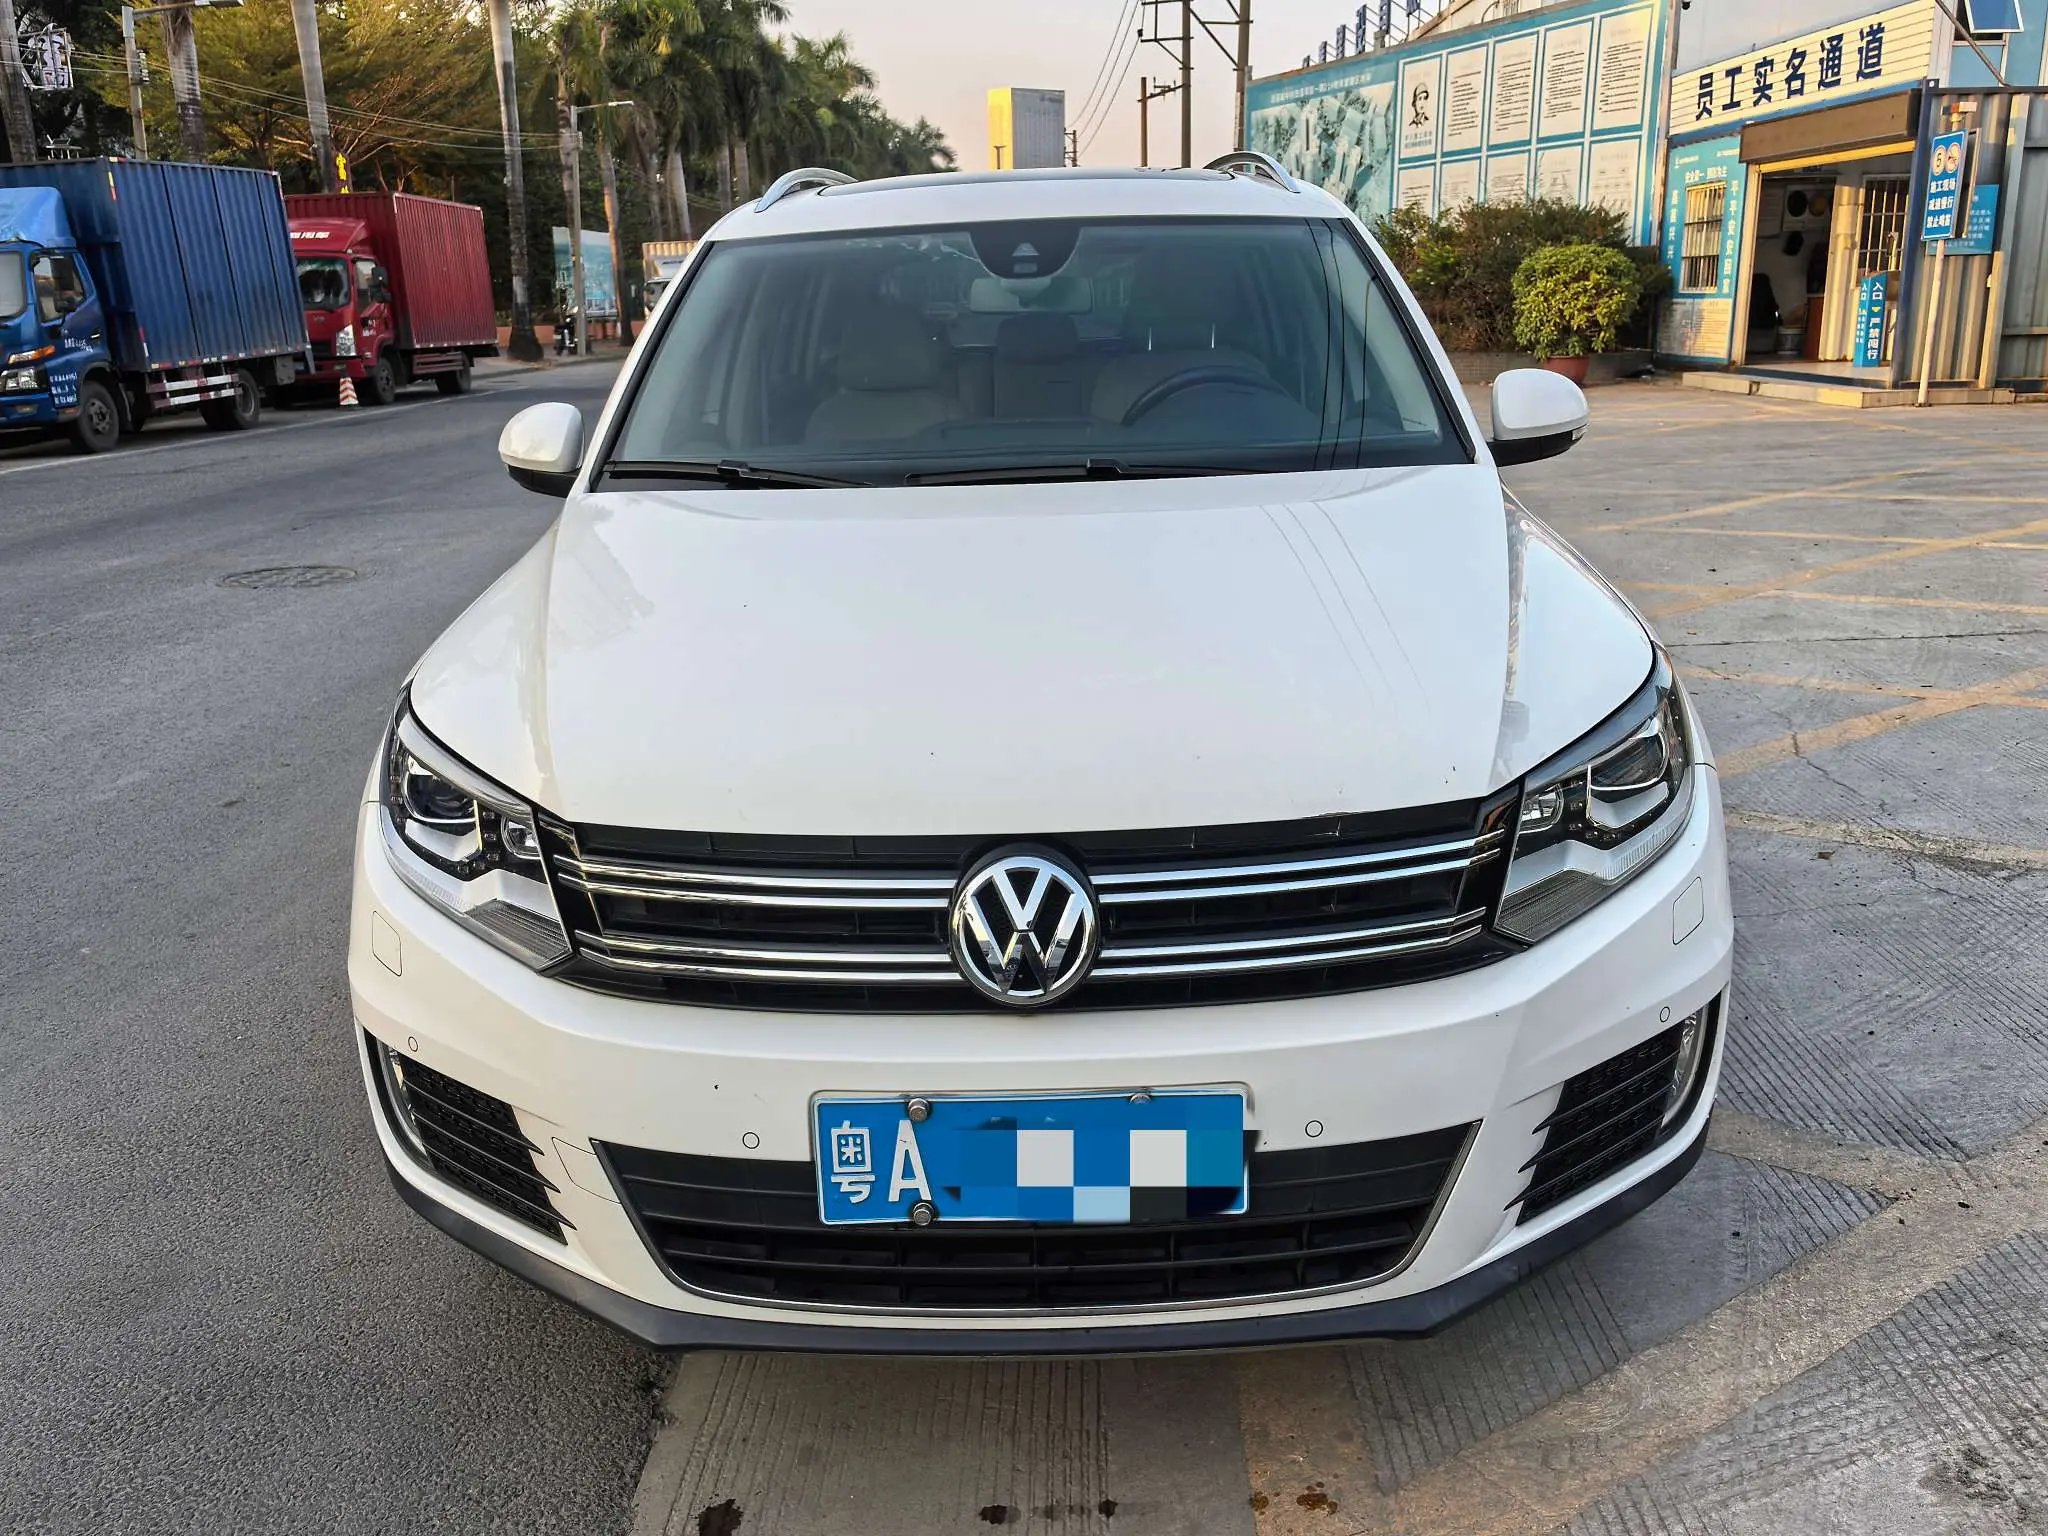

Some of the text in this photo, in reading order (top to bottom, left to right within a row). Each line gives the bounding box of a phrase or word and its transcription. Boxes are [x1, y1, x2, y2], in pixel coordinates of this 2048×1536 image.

[1696, 22, 1886, 121] 员工实名通道
[1930, 178, 1956, 193] 施工现场
[1928, 196, 1954, 211] 减速慢行
[1926, 214, 1952, 229] 禁止鸣笛
[1861, 282, 1868, 300] 入口
[1867, 281, 1884, 360] 入口 严禁闯行
